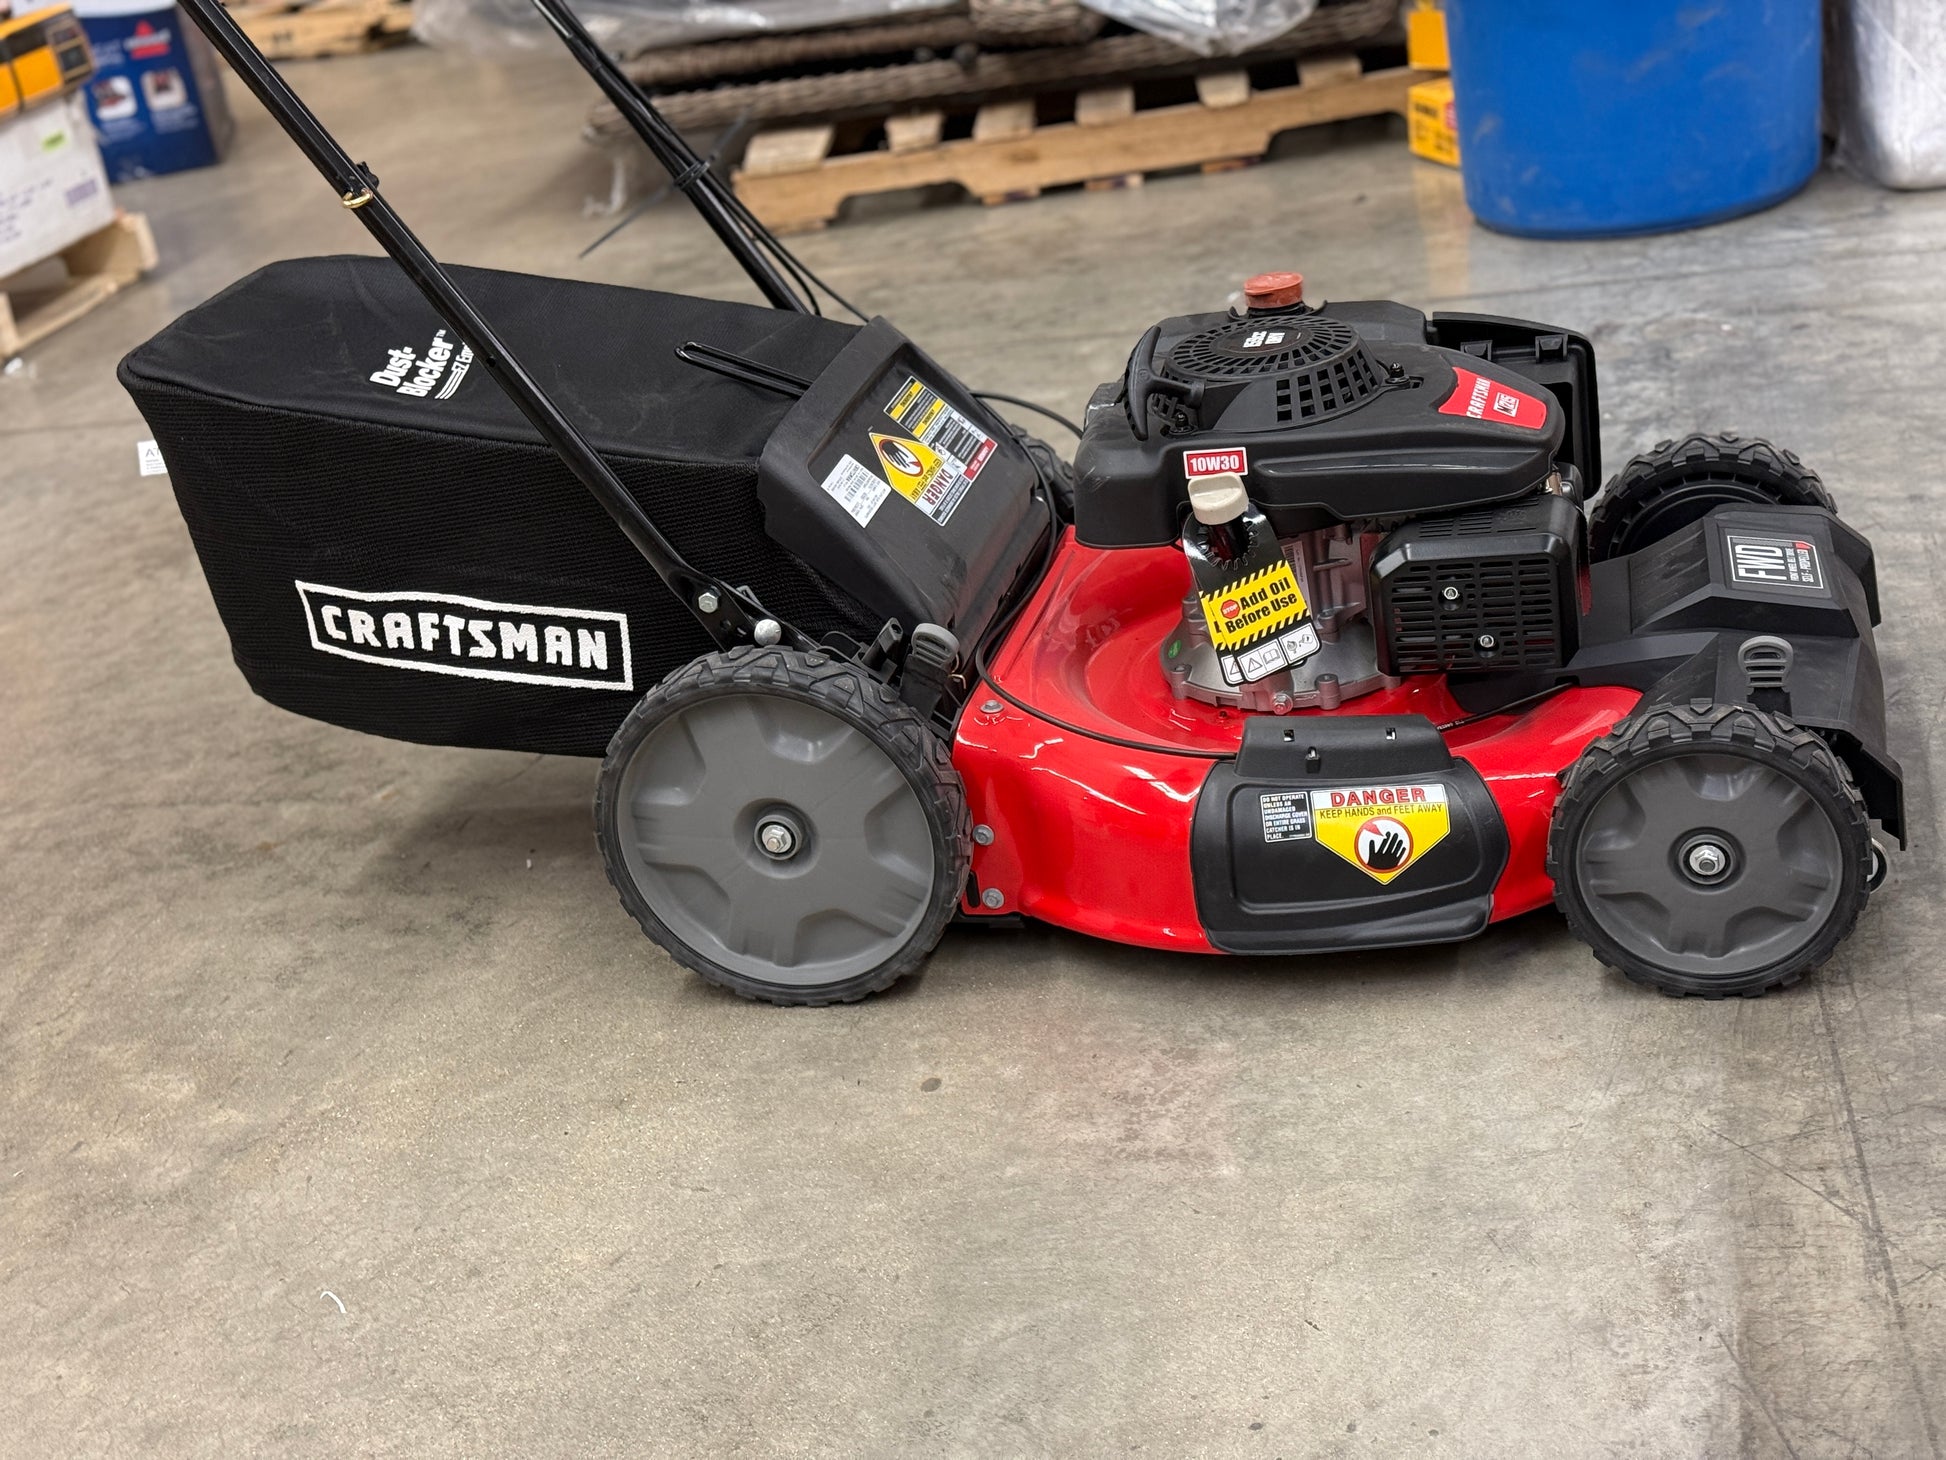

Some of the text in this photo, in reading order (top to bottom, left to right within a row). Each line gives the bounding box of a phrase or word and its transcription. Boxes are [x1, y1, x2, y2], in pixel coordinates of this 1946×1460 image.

[369, 346, 417, 388] Dust-
[1465, 376, 1492, 419] CRAFTSMAN
[1189, 454, 1240, 473] 10W30
[921, 467, 954, 506] DANGER
[1735, 545, 1787, 580] FWD
[1222, 603, 1239, 614] STOP
[1240, 577, 1291, 611] Add Oil
[1225, 605, 1271, 634] Before
[1270, 593, 1298, 612] Use
[321, 605, 608, 671] CRAFTSMAN
[1319, 803, 1444, 819] KEEP HANDS and FEET AWAY
[1330, 788, 1427, 807] DANGER
